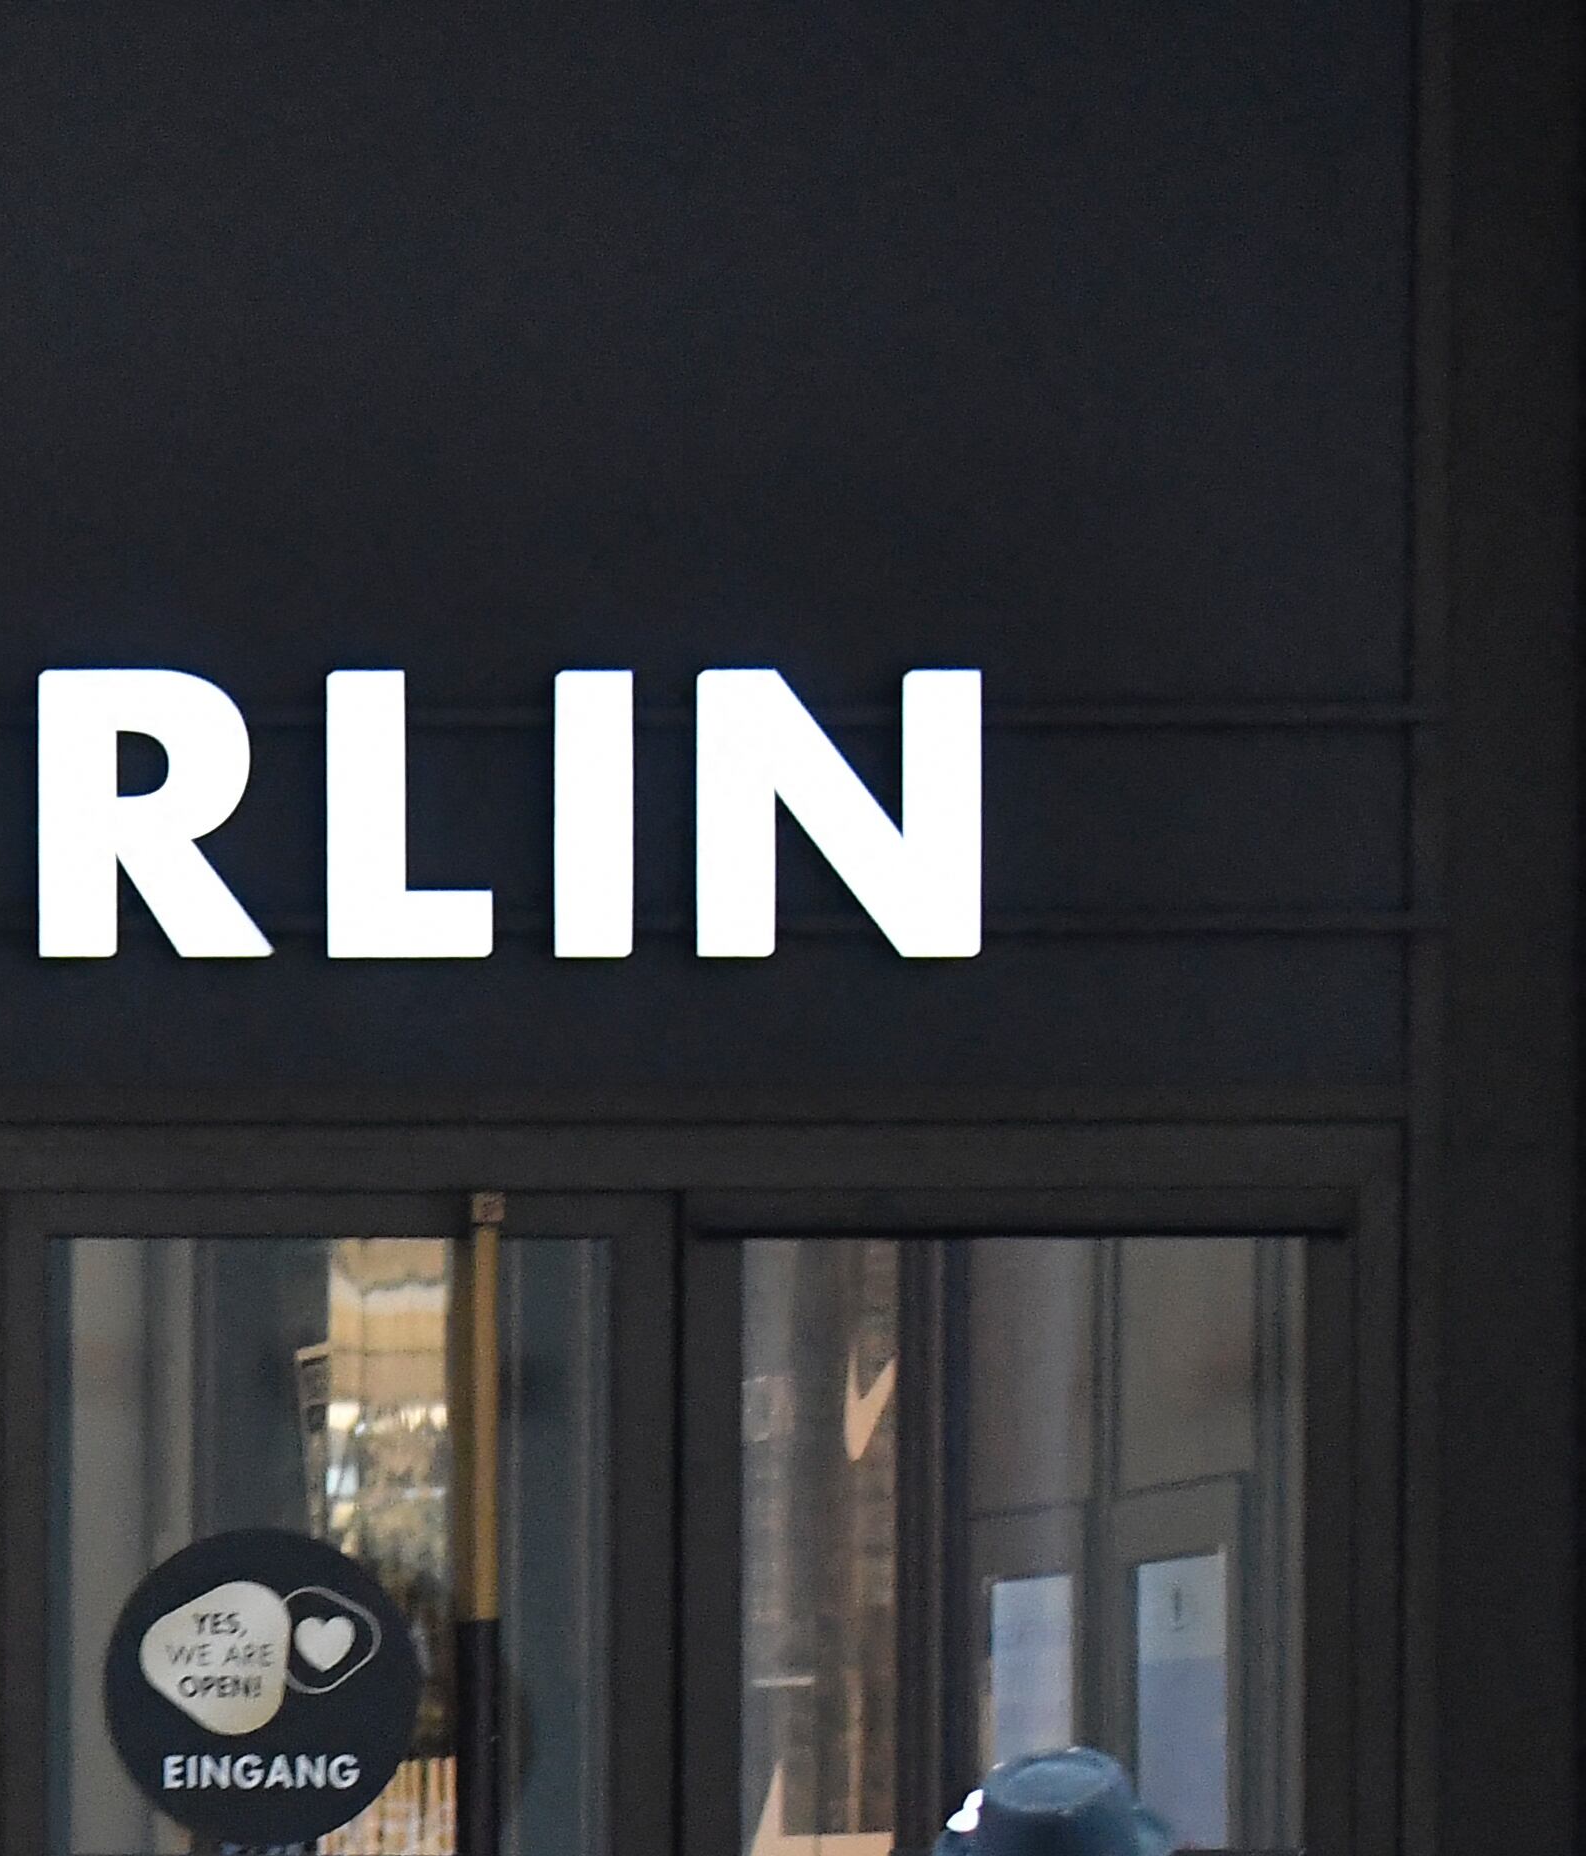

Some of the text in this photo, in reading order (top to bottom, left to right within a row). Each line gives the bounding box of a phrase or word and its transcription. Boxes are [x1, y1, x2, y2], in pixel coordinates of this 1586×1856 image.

[194, 1612, 248, 1638] YES,
[165, 1643, 275, 1667] WE ARE
[178, 1675, 263, 1701] OPEN!
[162, 1753, 361, 1790] EINGANG
